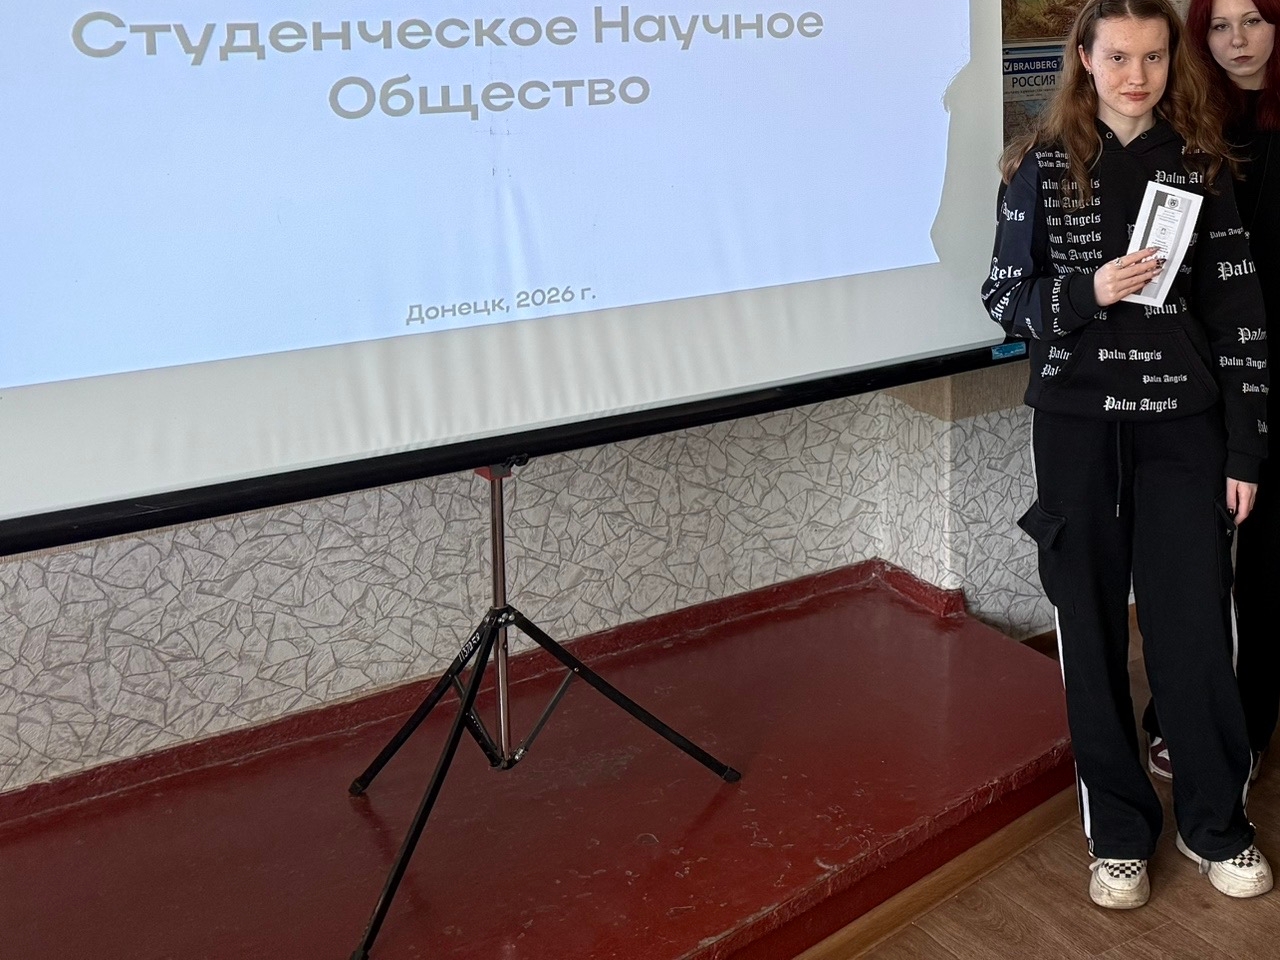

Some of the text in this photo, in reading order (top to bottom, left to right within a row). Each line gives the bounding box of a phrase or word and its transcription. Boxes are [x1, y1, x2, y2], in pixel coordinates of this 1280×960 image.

[72, 5, 825, 65] Студенческое Научное
[1013, 60, 1058, 71] BRAUBERG
[1012, 74, 1056, 88] РОССИЯ
[329, 73, 651, 121] Общество
[1035, 151, 1054, 159] Palm
[1038, 160, 1055, 168] Palm
[1154, 170, 1186, 184] Palm
[1042, 179, 1059, 190] alm
[1064, 213, 1101, 227] Angels
[1066, 231, 1101, 244] Angels
[1068, 249, 1102, 261] Angels
[405, 285, 597, 326] Донецк, 2026 г.
[1098, 348, 1162, 362] Palm Angels
[1219, 356, 1267, 369] Palm Angel
[1041, 364, 1061, 377] Pal
[1142, 374, 1187, 384] Palm Angels
[1242, 382, 1260, 394] Palm
[1103, 395, 1178, 412] Palm Angels
